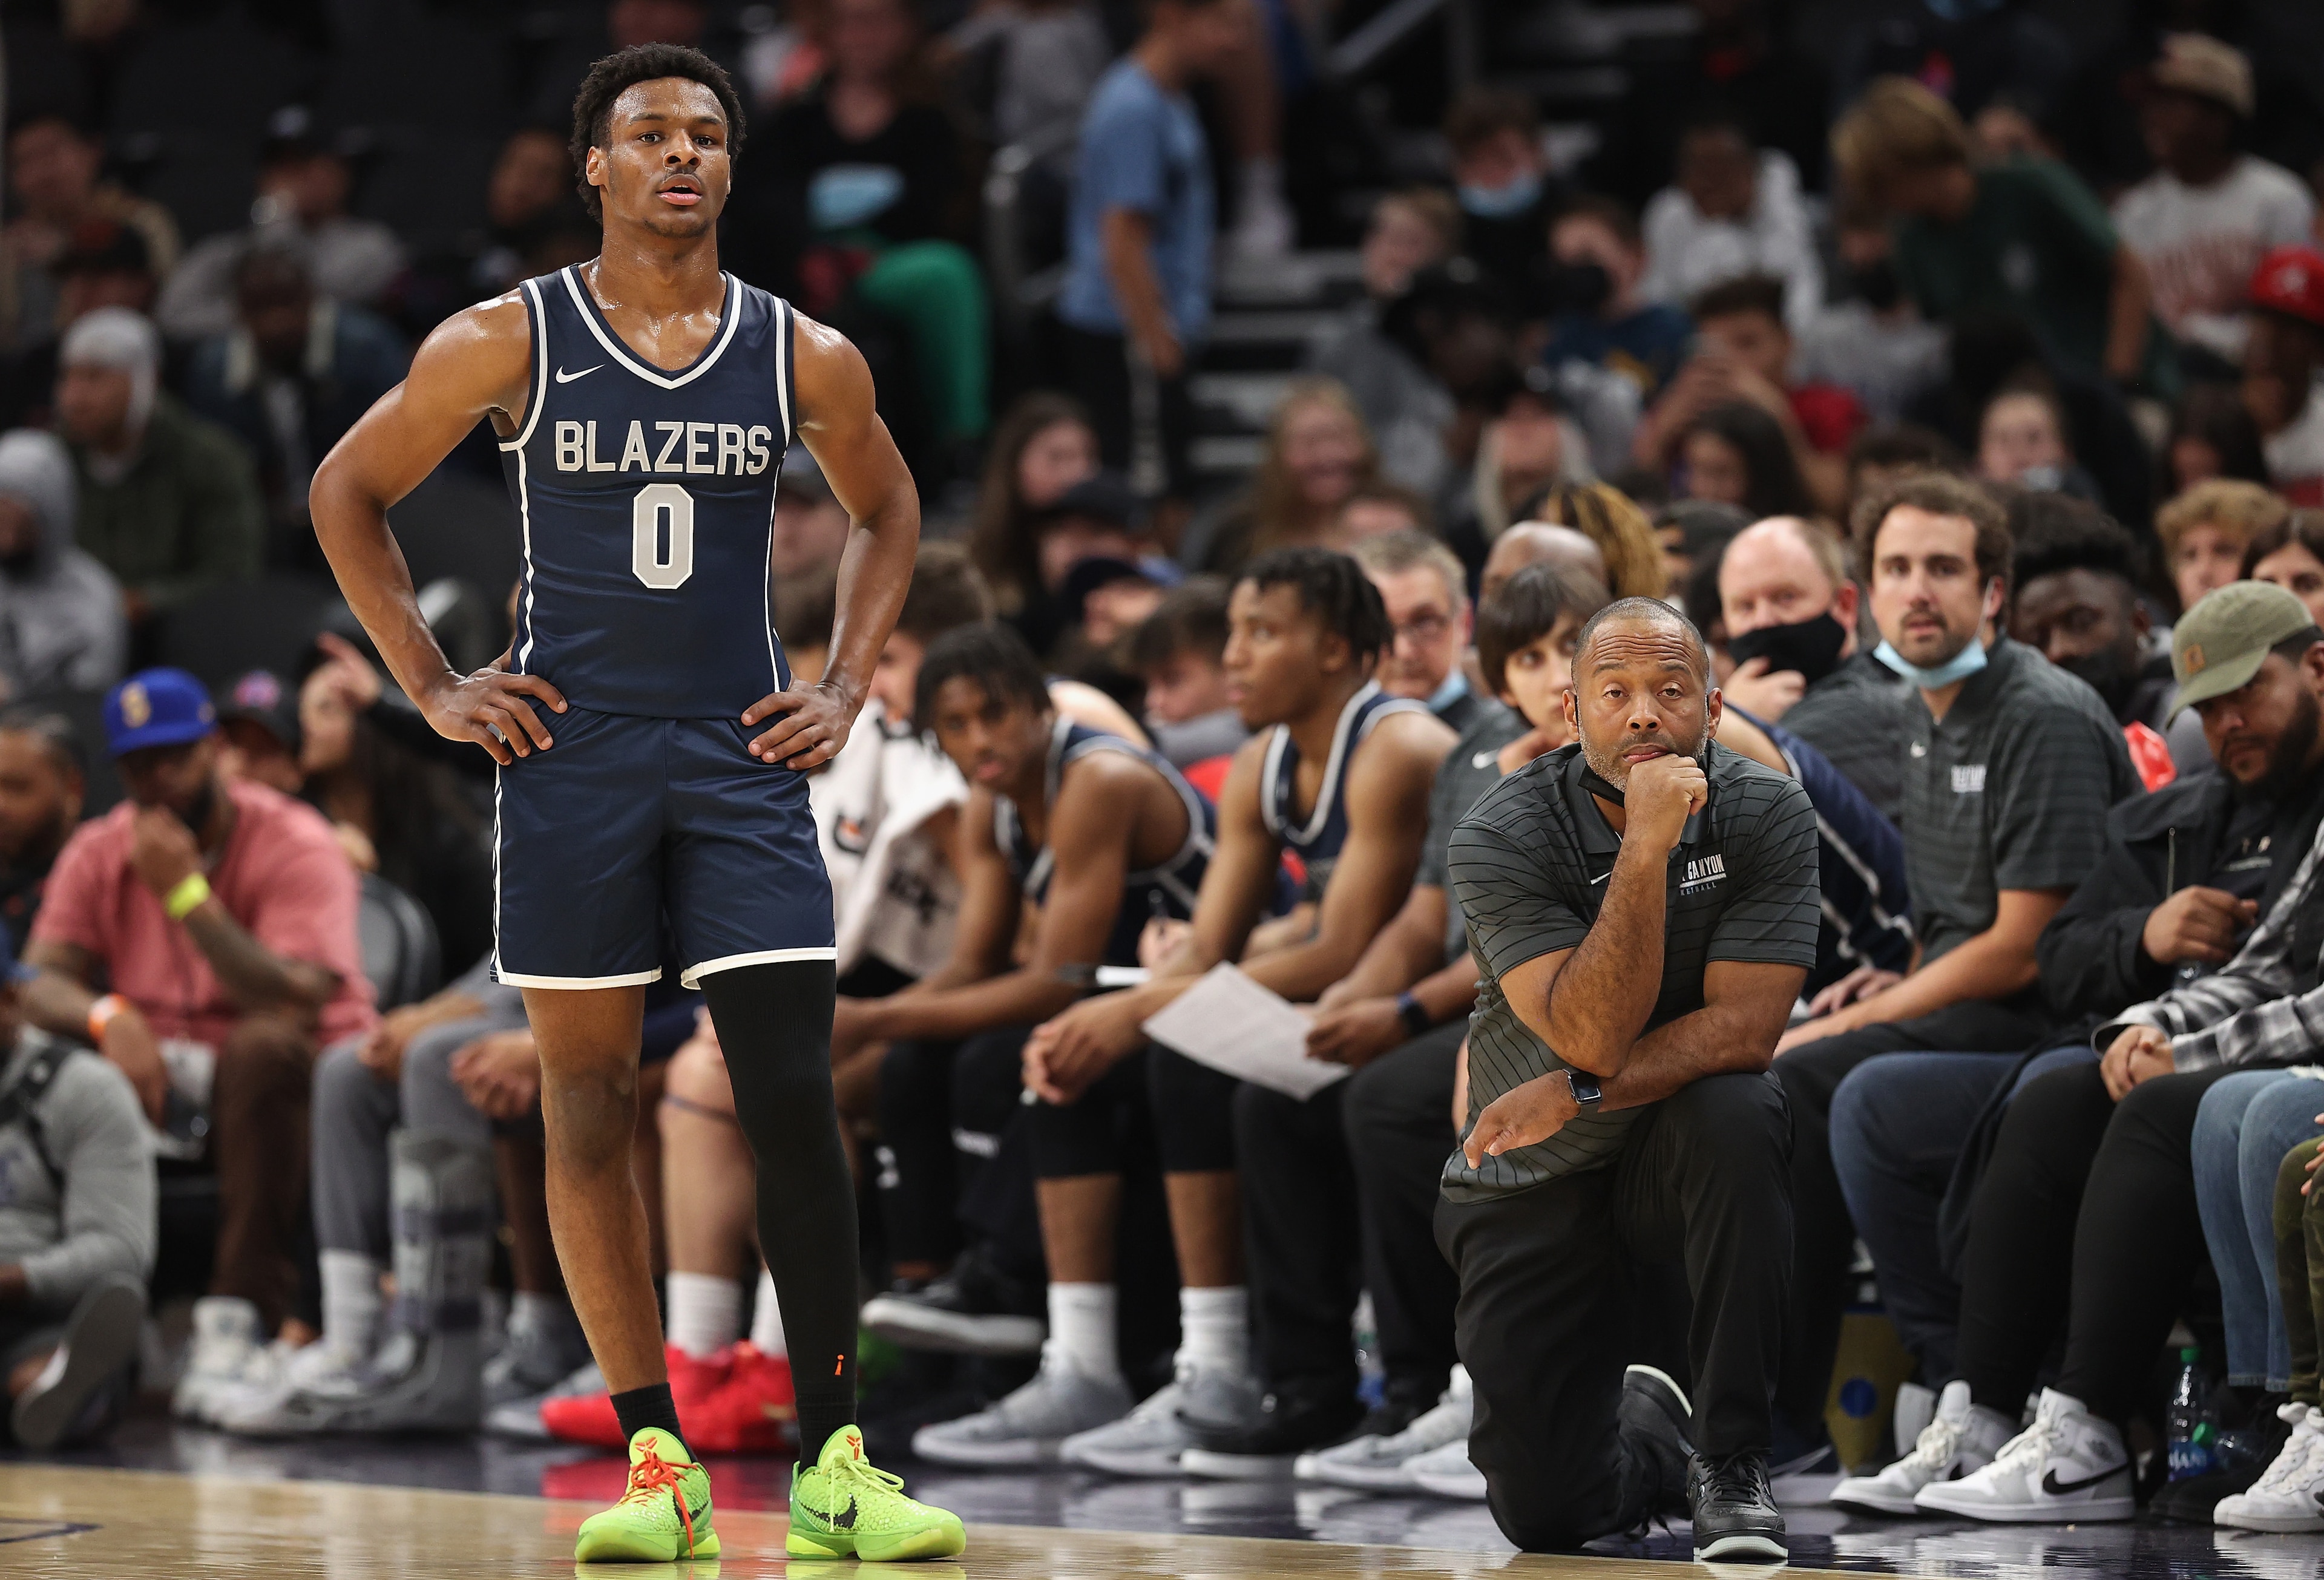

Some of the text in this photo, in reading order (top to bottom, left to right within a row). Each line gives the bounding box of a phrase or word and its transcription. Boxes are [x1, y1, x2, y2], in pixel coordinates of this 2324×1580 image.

[556, 421, 772, 475] BLAZERS
[633, 484, 694, 589] 0
[1688, 854, 1725, 880] CANYON
